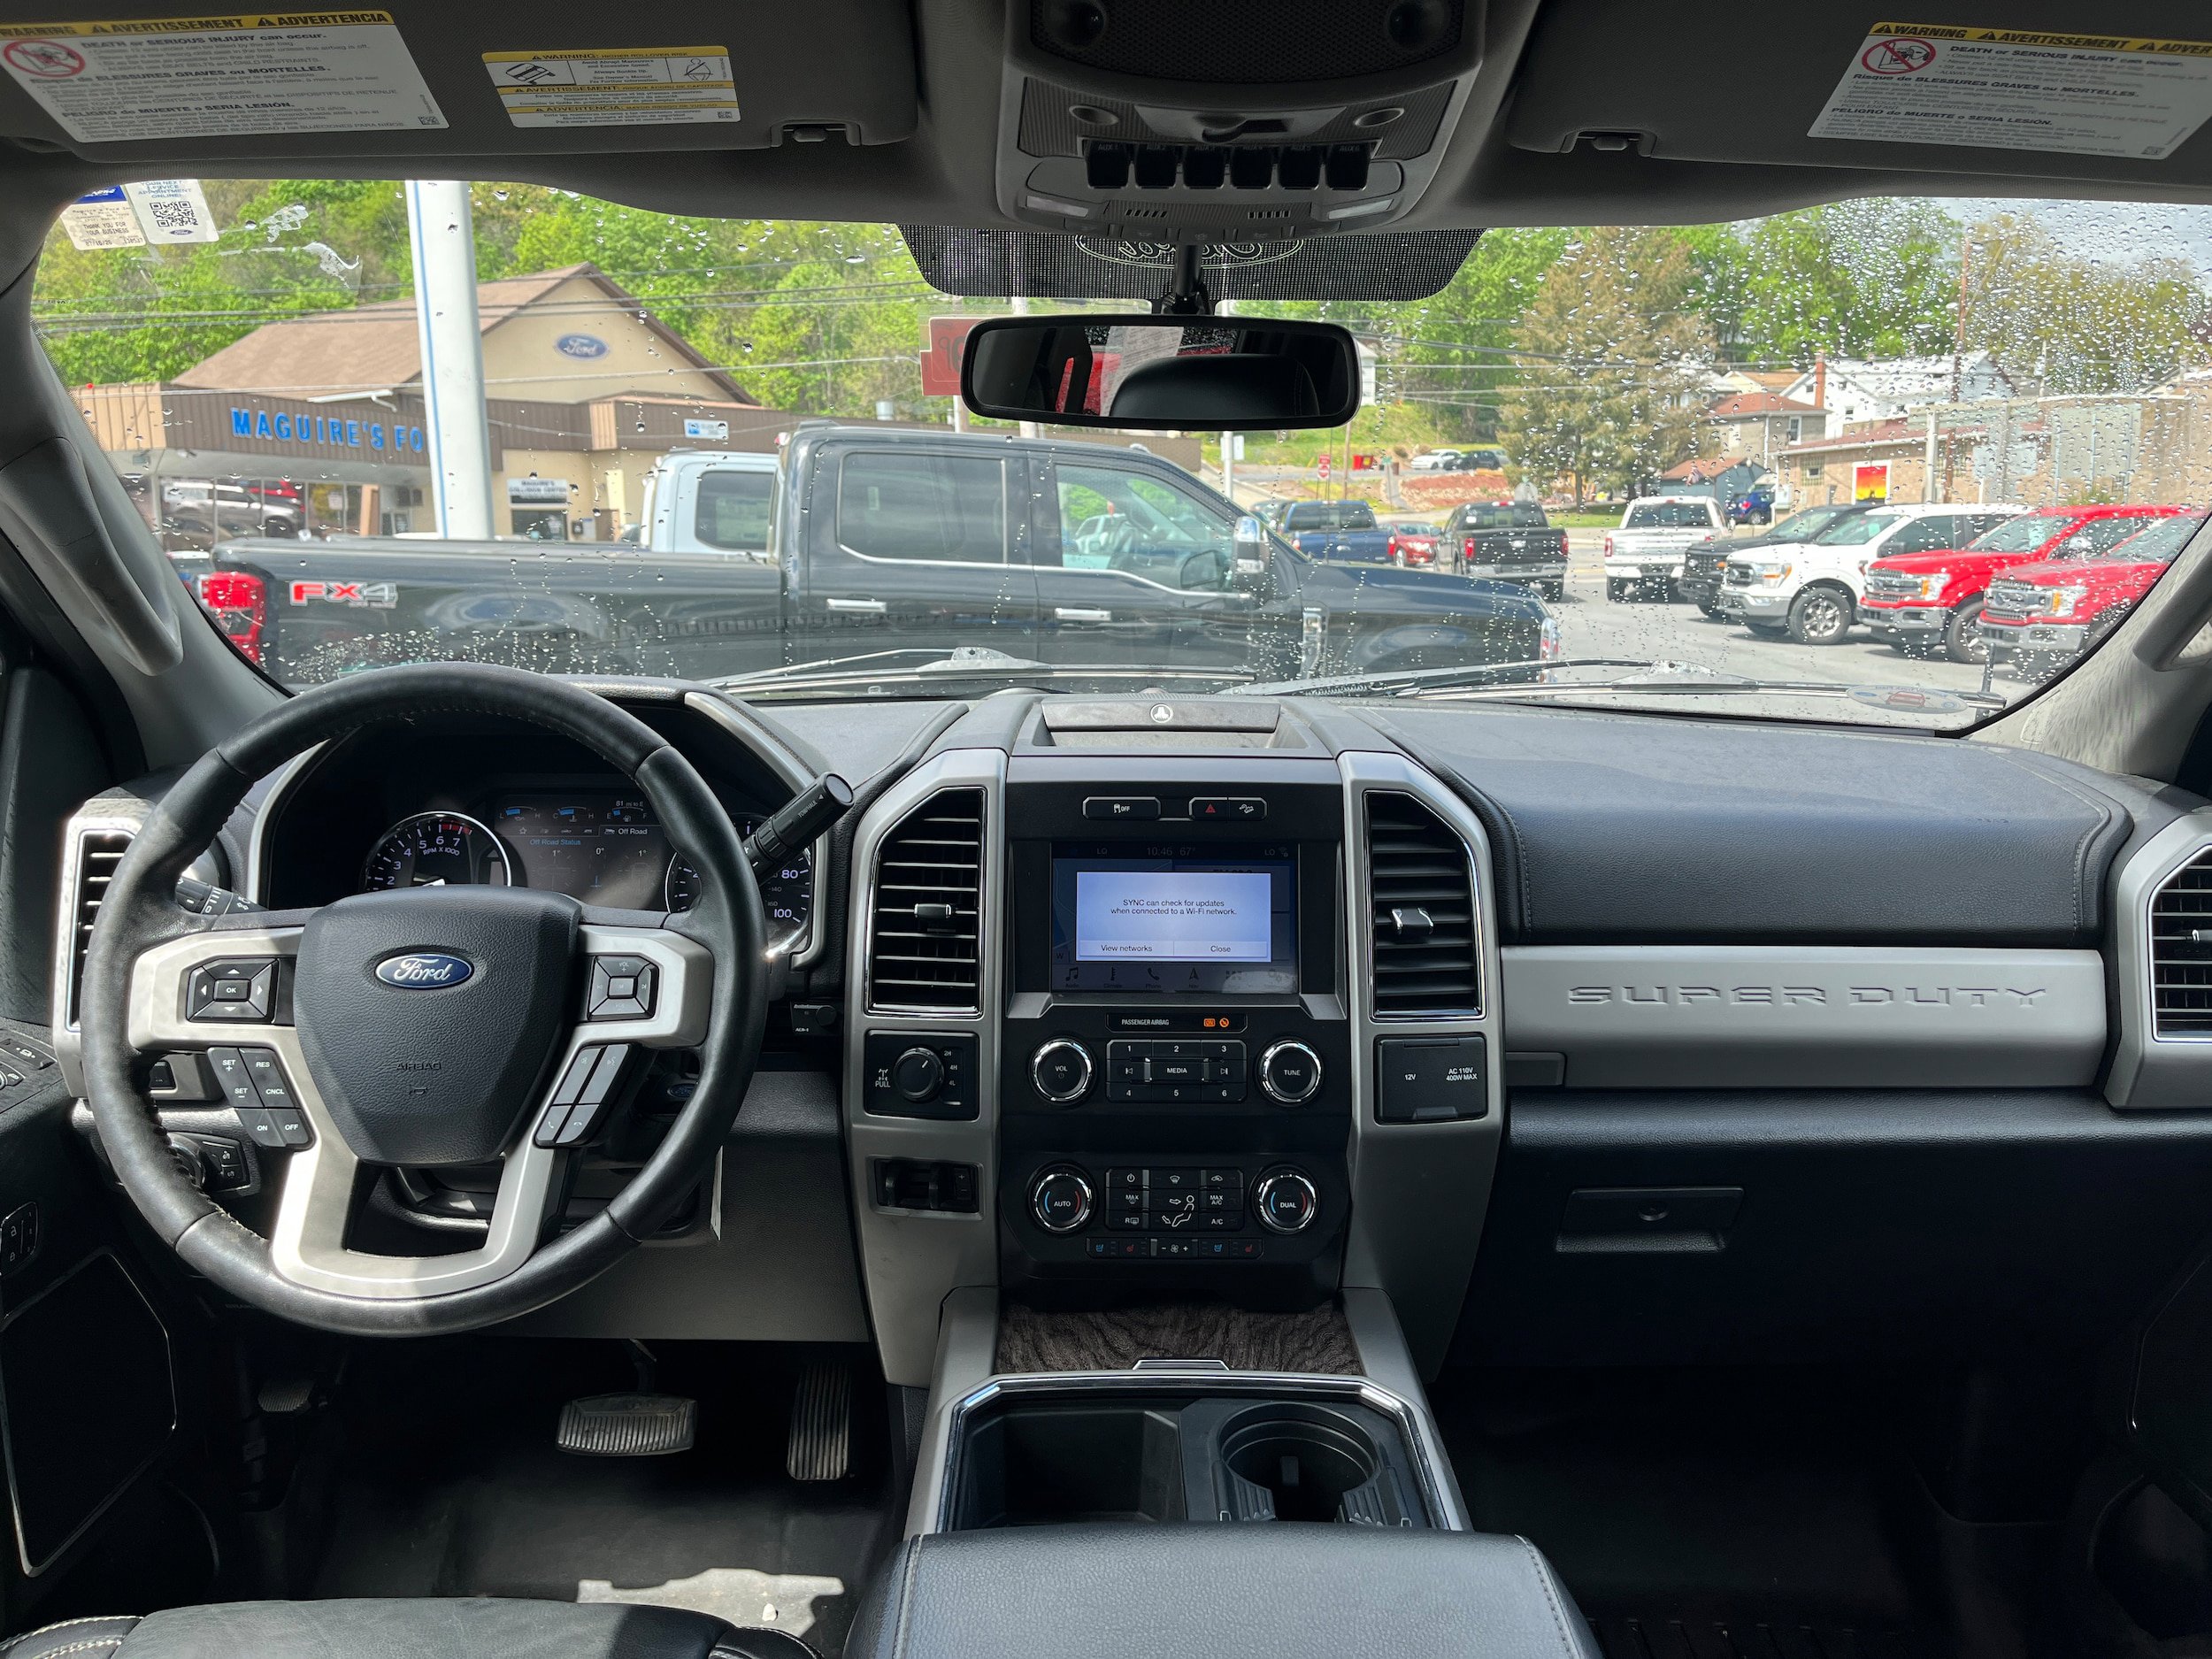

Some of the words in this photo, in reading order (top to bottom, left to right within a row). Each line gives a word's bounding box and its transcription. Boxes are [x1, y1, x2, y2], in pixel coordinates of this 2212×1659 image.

[111, 18, 244, 34] AVERTISSEMENT
[278, 13, 389, 26] ADVERTENCIA
[1894, 25, 1968, 39] WARNING
[2001, 32, 2130, 49] AVERTISSEMENT
[1950, 45, 1993, 54] DEATH
[2012, 50, 2069, 59] SERIOUS
[96, 73, 172, 81] BLESSURES
[248, 65, 331, 74] MORTELLES.
[1915, 76, 1987, 87] BLESSURES
[1991, 81, 2040, 90] GRAVES
[2061, 87, 2139, 97] MORTELLES.
[1904, 111, 1955, 119] MUERTE
[2008, 116, 2053, 126] LESIÓN.
[231, 406, 386, 451] MAGUIRE'S
[394, 425, 430, 453] FO
[289, 580, 398, 607] FX4
[419, 841, 427, 849] 5
[435, 836, 444, 845] 6
[452, 838, 461, 847] 7
[403, 848, 412, 856] 4
[423, 847, 437, 856] RPM
[444, 847, 460, 856] 1000
[394, 861, 402, 870] 3
[781, 869, 799, 879] 80
[1195, 899, 1225, 909] updates
[774, 908, 792, 918] 100
[1119, 944, 1153, 953] networks
[1210, 944, 1231, 953] Close
[394, 957, 453, 981] Ford
[1567, 985, 1827, 1006] SUPER
[1848, 986, 2047, 1007] DUTY
[396, 1062, 442, 1071] AIRBAG
